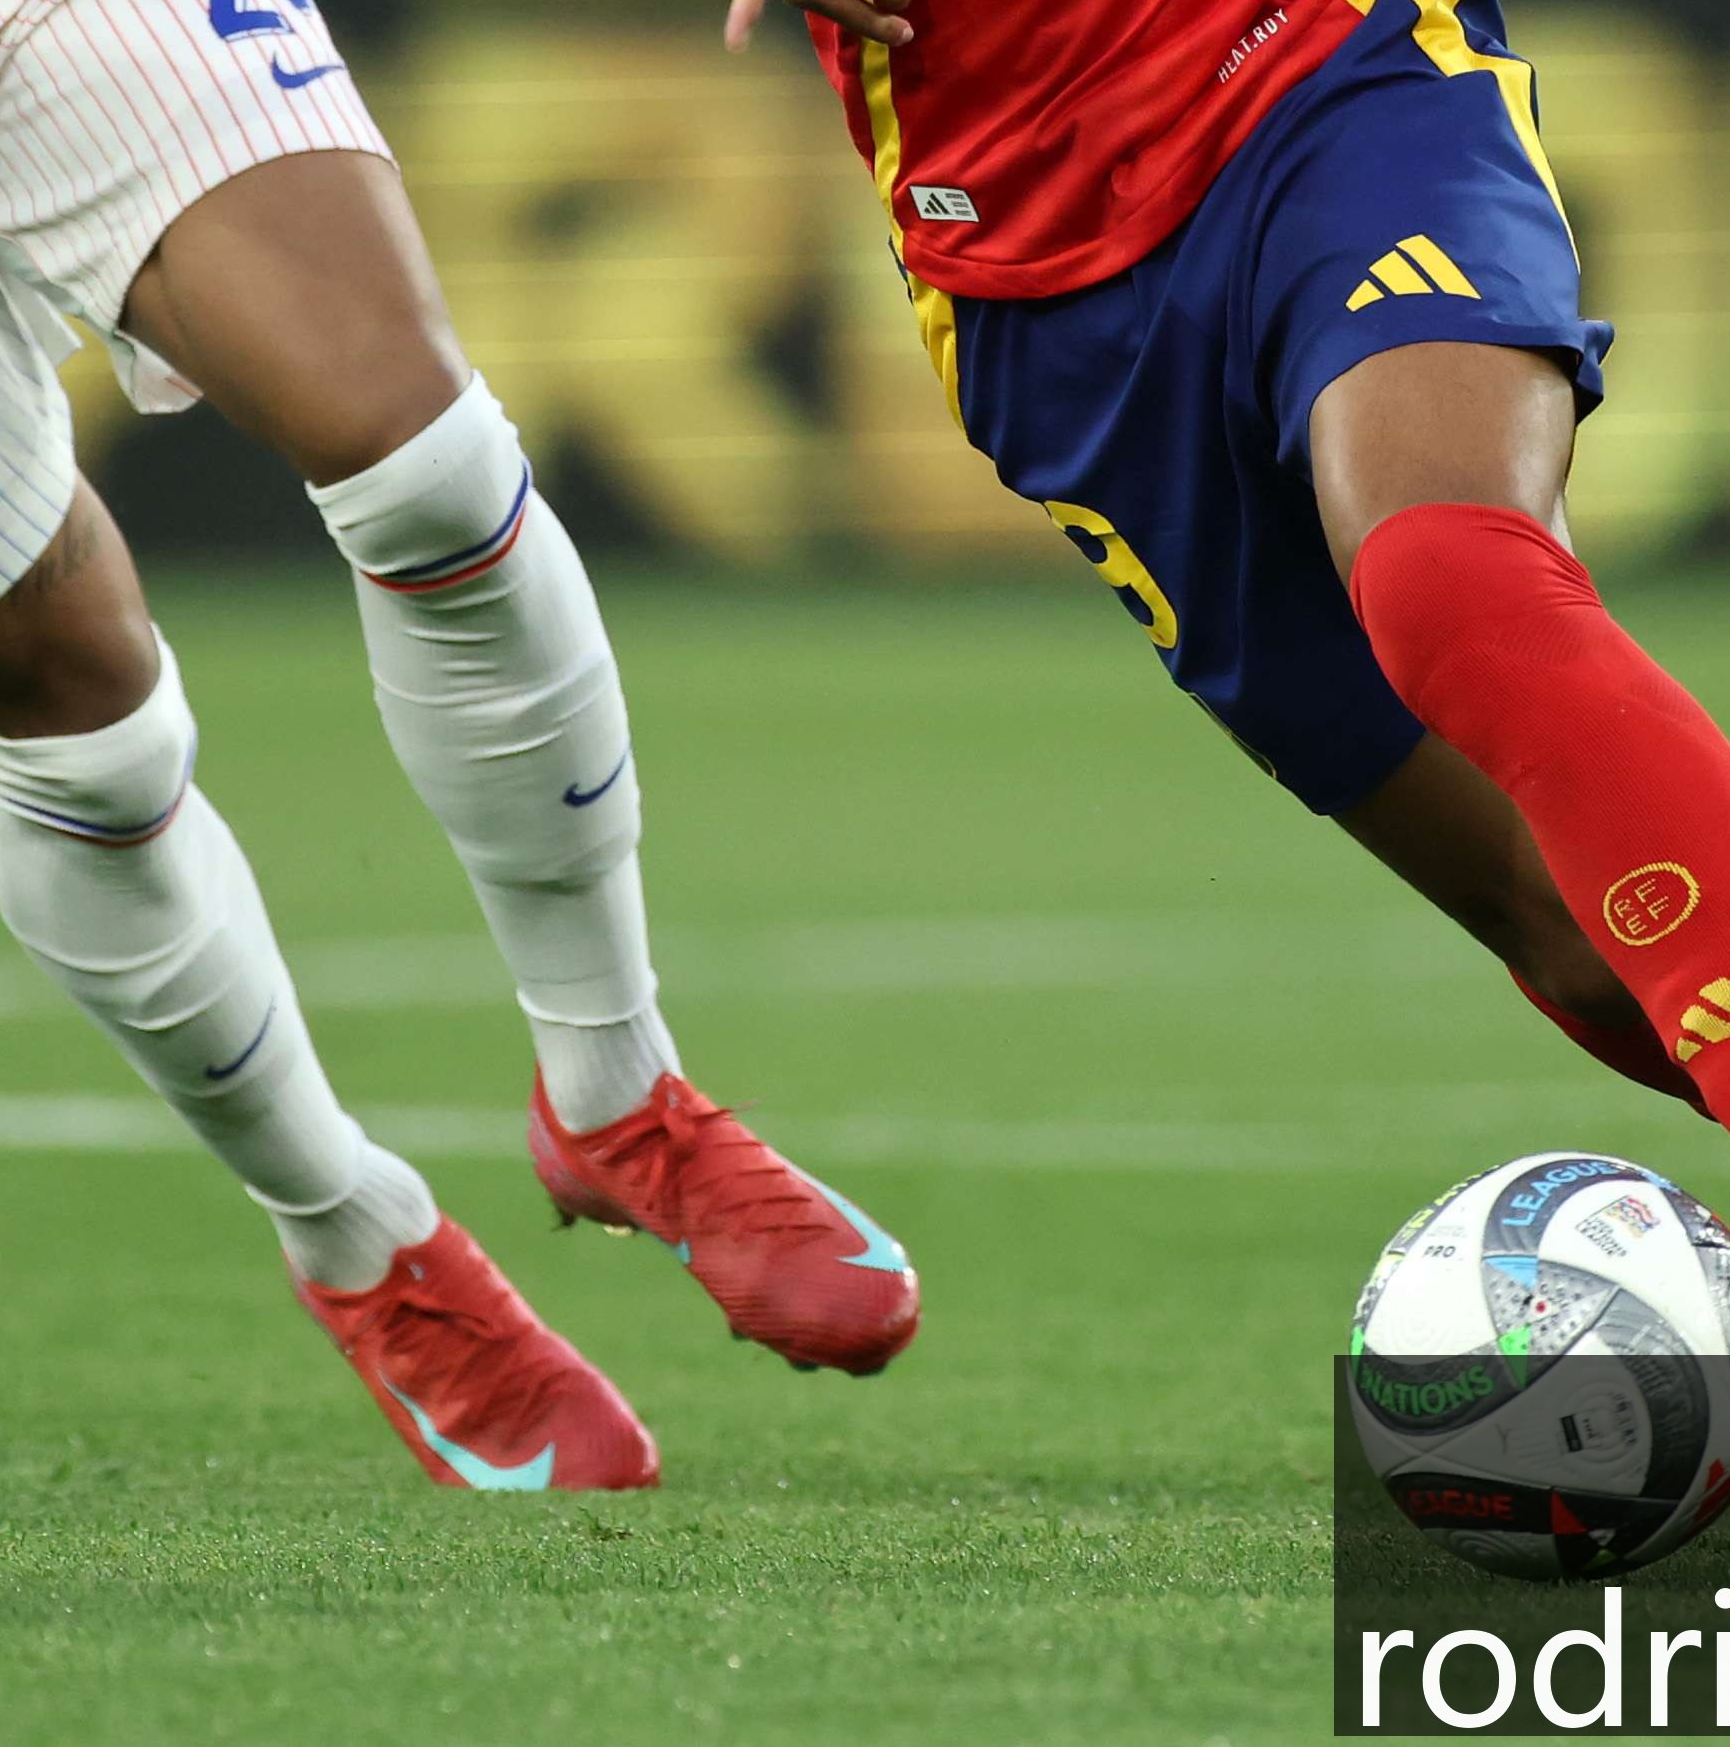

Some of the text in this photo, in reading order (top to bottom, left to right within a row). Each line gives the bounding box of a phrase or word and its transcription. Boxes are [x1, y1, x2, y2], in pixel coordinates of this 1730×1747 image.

[1501, 1161, 1619, 1228] LEAGUE
[1422, 1244, 1457, 1259] PRO
[1359, 1362, 1495, 1417] NATIONS
[1400, 1488, 1515, 1521] EAGUE
